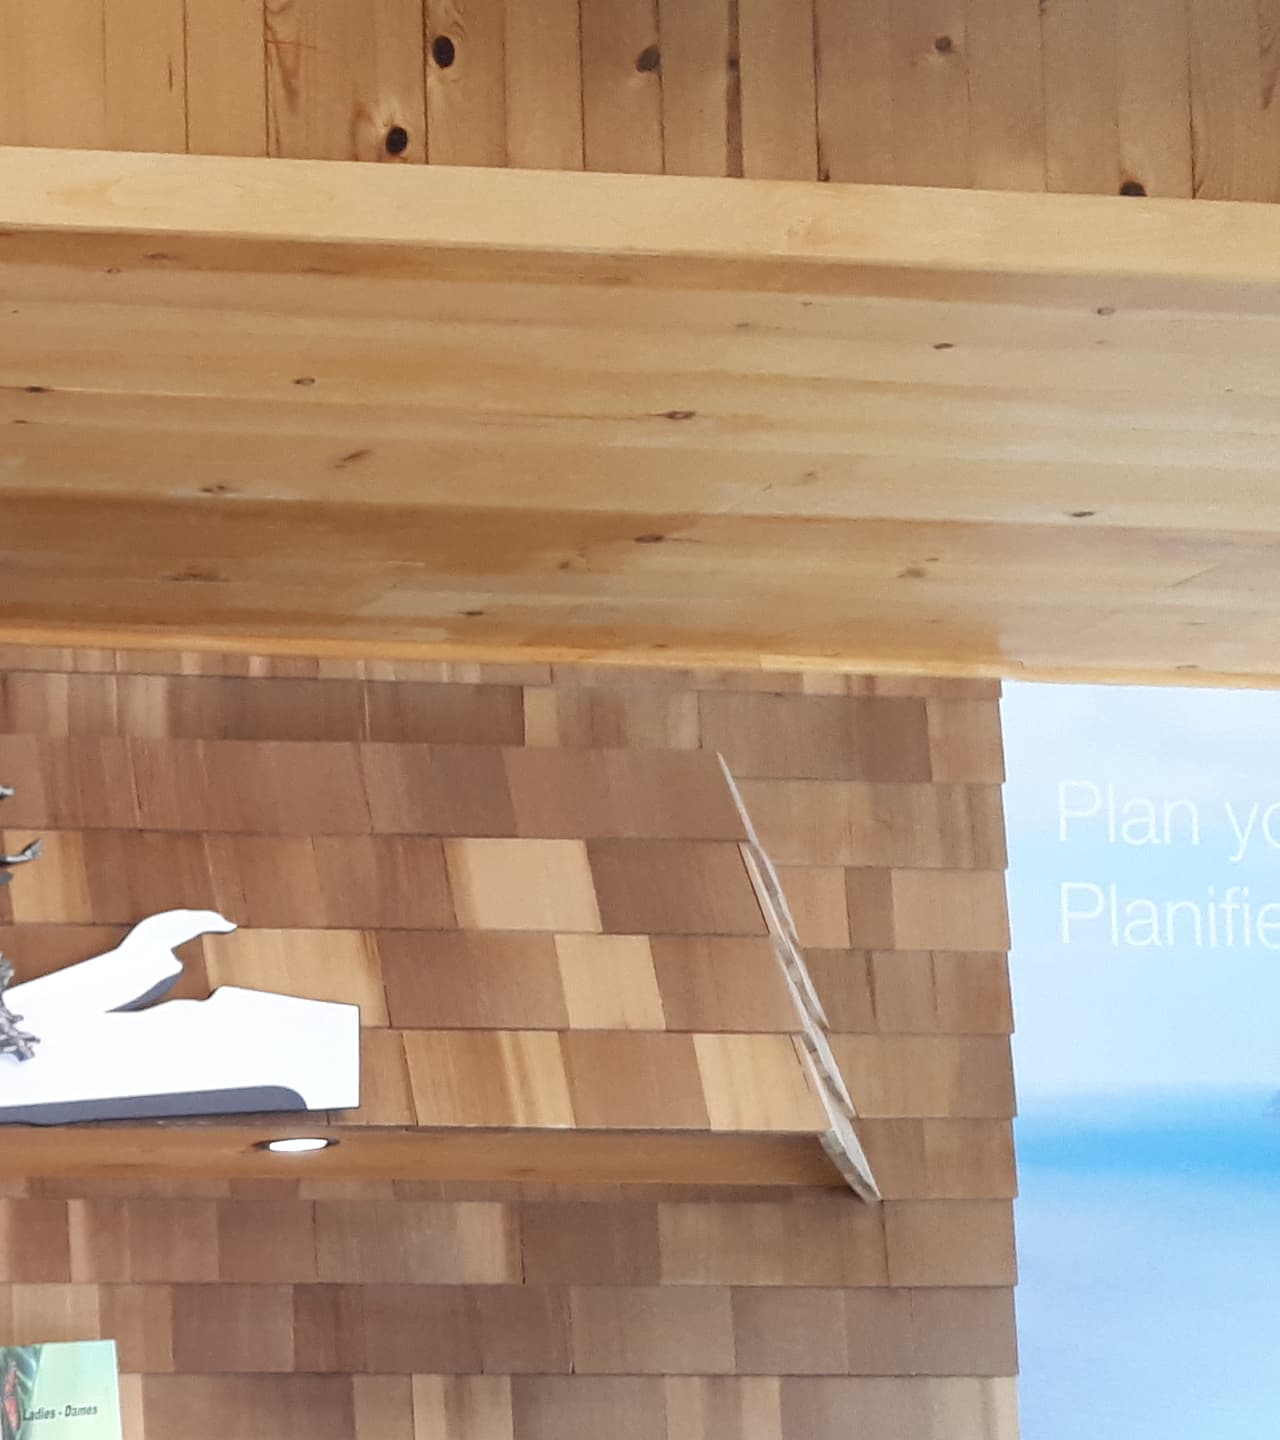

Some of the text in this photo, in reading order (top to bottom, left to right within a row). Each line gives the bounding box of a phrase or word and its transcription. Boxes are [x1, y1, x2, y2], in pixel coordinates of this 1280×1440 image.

[1057, 779, 1201, 846] Plan
[23, 1407, 56, 1421] Ladies
[64, 1404, 98, 1417] Dames
